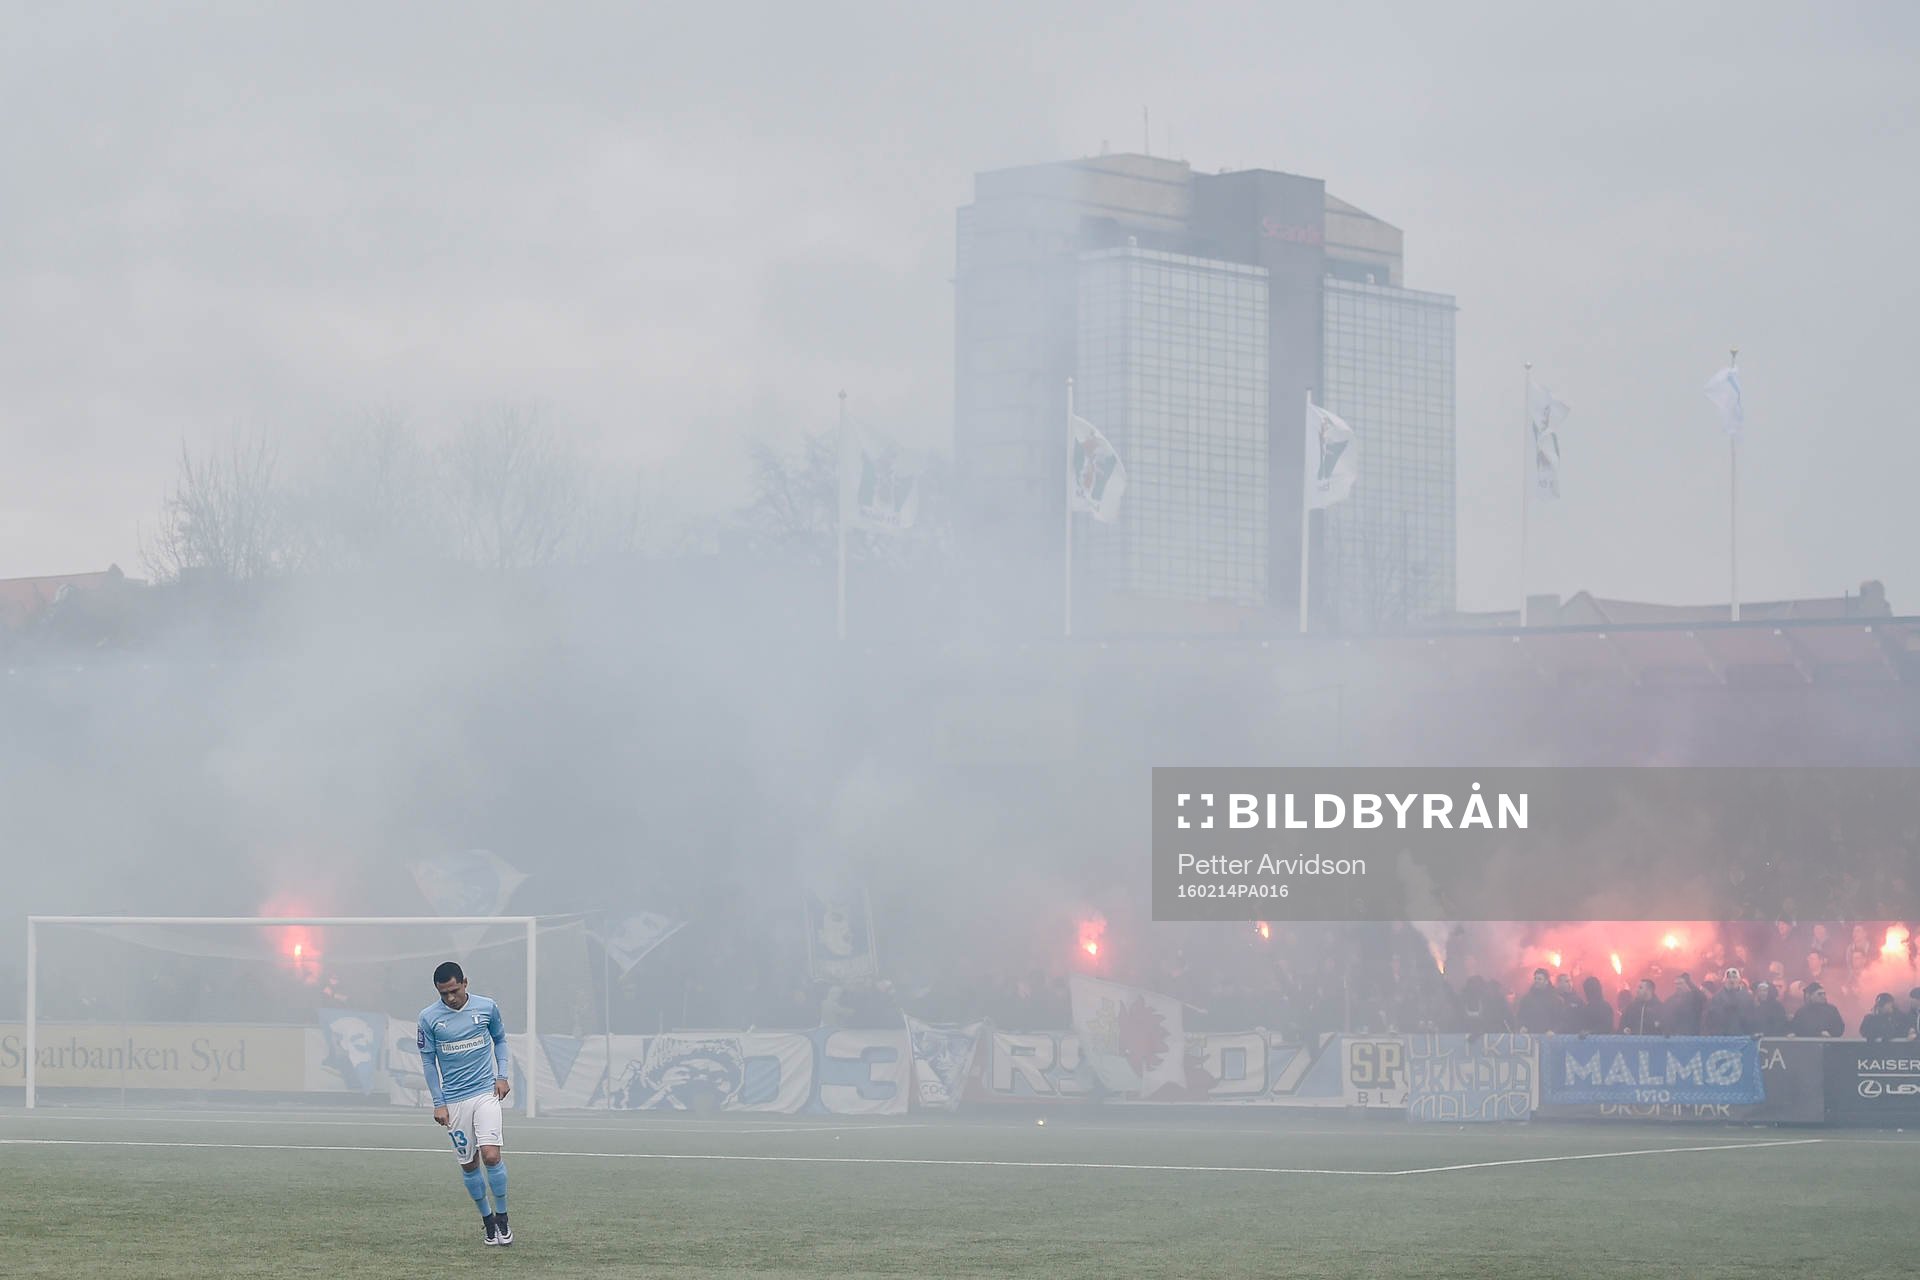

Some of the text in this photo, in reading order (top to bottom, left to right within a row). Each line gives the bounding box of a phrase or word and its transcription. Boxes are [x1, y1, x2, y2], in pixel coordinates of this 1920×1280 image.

[190, 1037, 246, 1081] Syd
[1857, 1059, 1920, 1070] KAISER
[449, 1131, 468, 1148] 13
